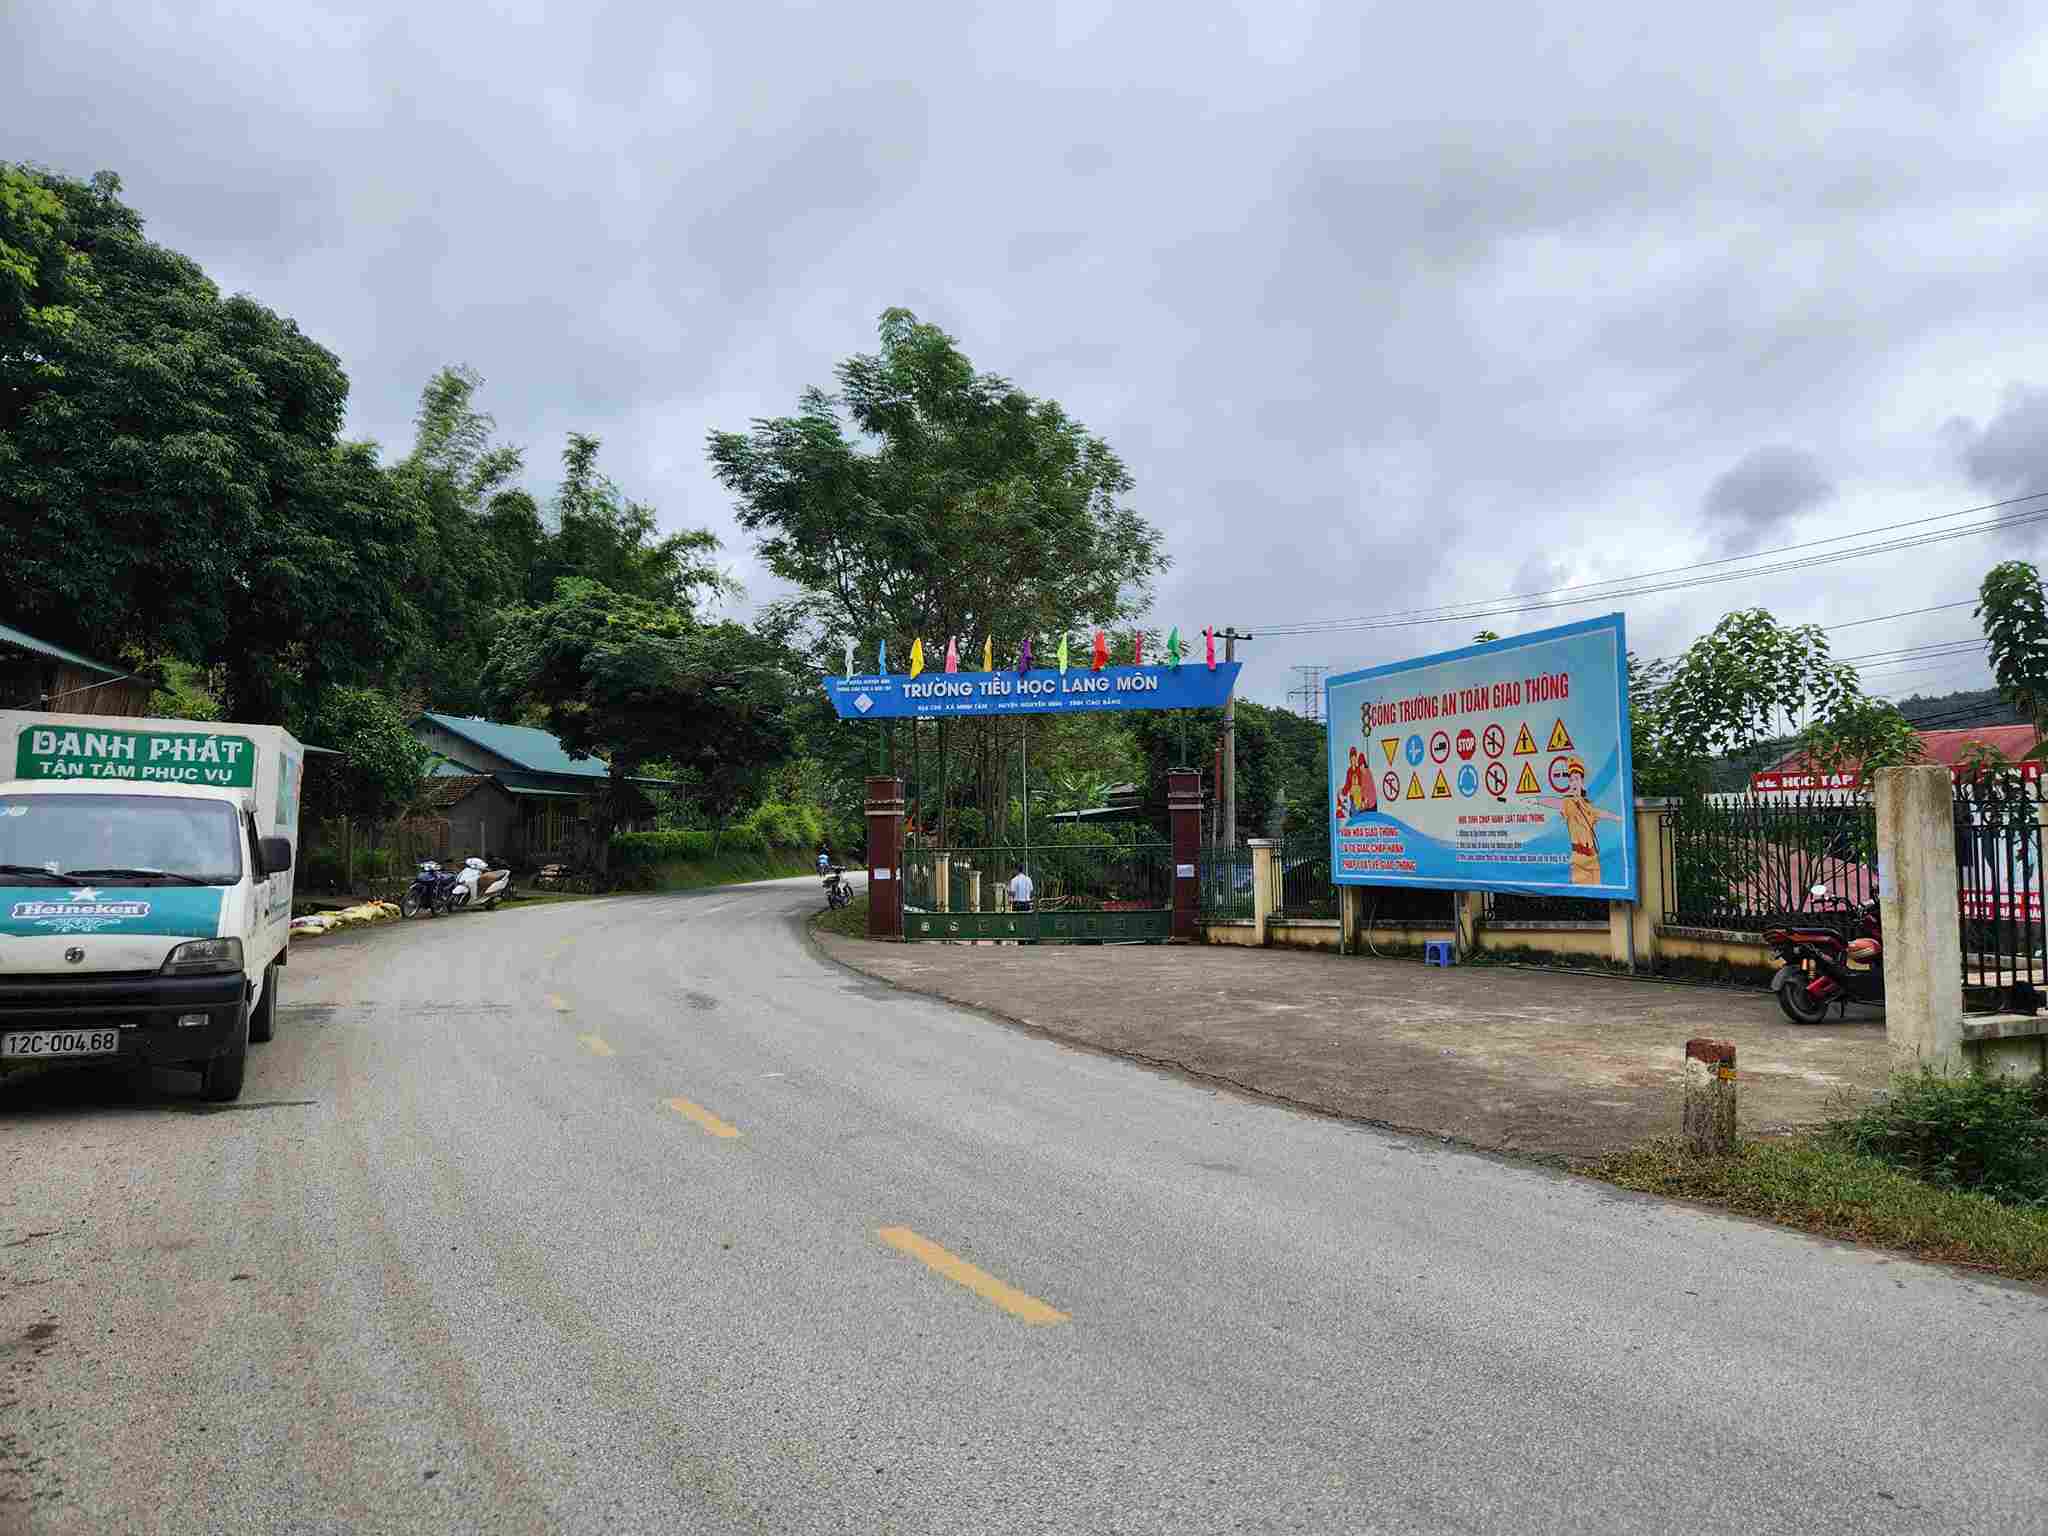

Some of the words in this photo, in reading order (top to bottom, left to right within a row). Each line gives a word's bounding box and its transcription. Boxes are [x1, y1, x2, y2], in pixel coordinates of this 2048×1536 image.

[903, 676, 972, 698] TRƯỜNG
[979, 672, 1010, 697] TIỂU
[1017, 679, 1056, 698] HỌC
[1062, 676, 1110, 693] LANG
[1117, 672, 1158, 691] MÔN
[1400, 692, 1438, 722] TRƯỜNG
[1442, 693, 1457, 716] AN
[1460, 684, 1489, 713] TOÀN
[1493, 681, 1520, 708] GIAO
[1525, 672, 1569, 705] THÔNG
[149, 734, 242, 763] PHÁT
[1457, 739, 1475, 749] STOP
[40, 759, 83, 779] TẬN
[89, 761, 135, 778] TÂM
[141, 765, 198, 784] PHỤC
[204, 768, 232, 785] VỤ
[23, 903, 139, 914] Heineken
[8, 1033, 115, 1054] 12C-004.68
